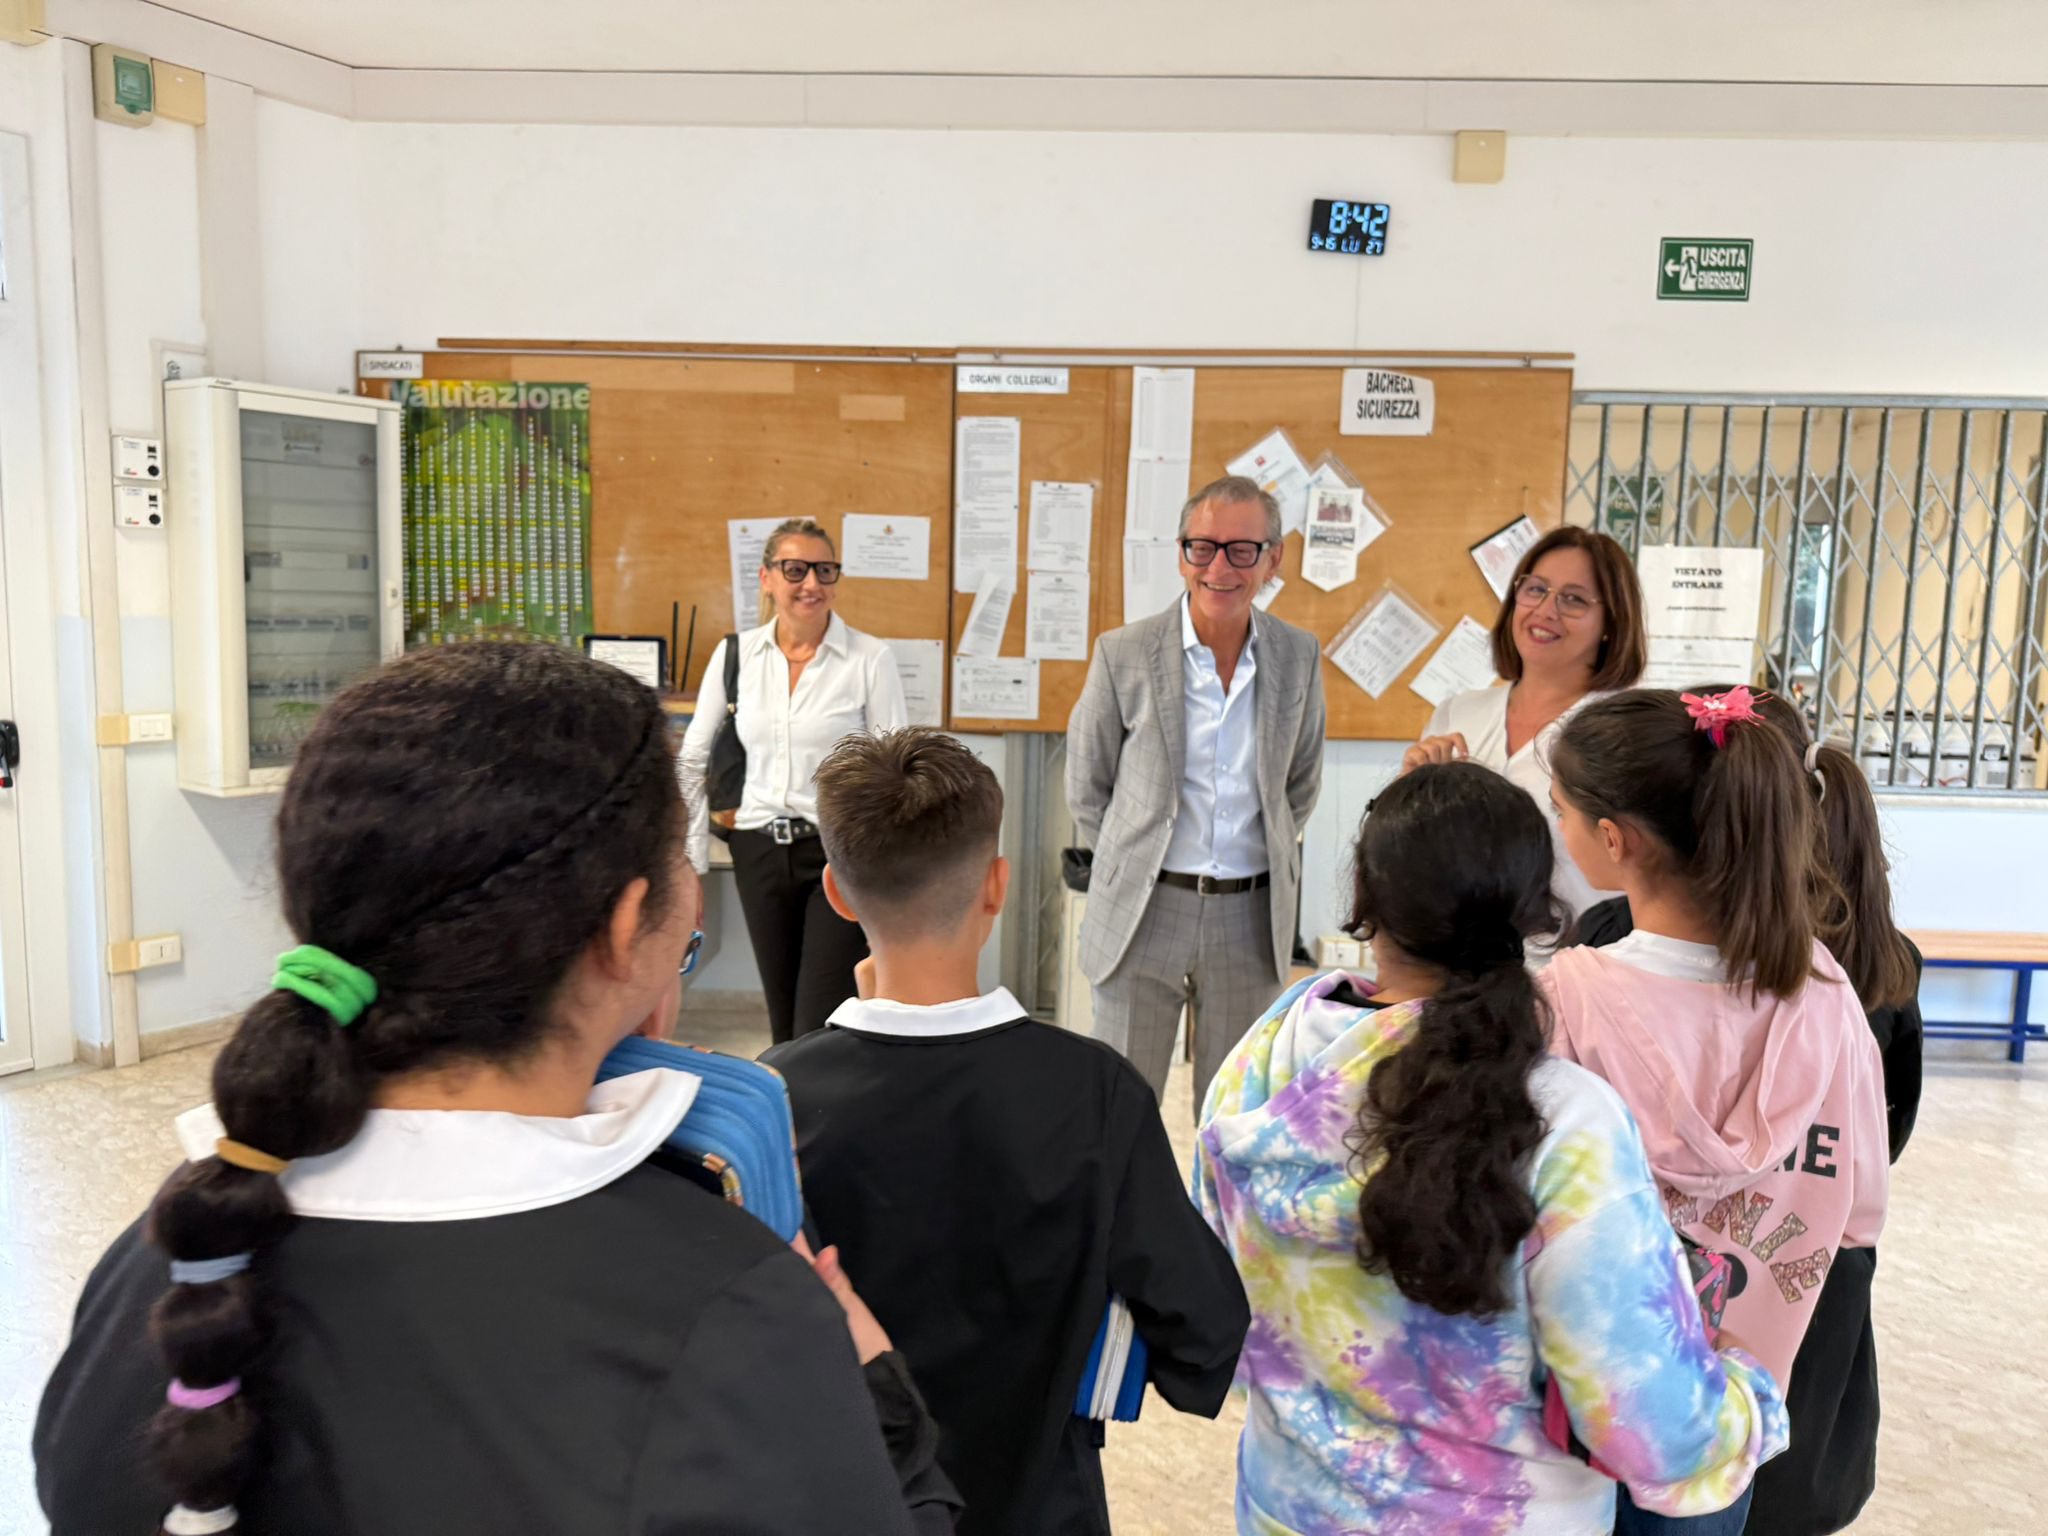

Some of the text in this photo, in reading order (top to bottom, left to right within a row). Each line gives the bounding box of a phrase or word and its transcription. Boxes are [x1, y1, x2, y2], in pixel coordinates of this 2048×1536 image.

[1329, 201, 1388, 237] 8:42
[1700, 247, 1747, 267] USCITA
[1366, 372, 1415, 394] BACHECA
[391, 379, 591, 410] Valutazione
[1356, 399, 1420, 419] SICUREZZA
[1674, 567, 1723, 577] VIETATO
[1671, 581, 1724, 590] ENTRARE
